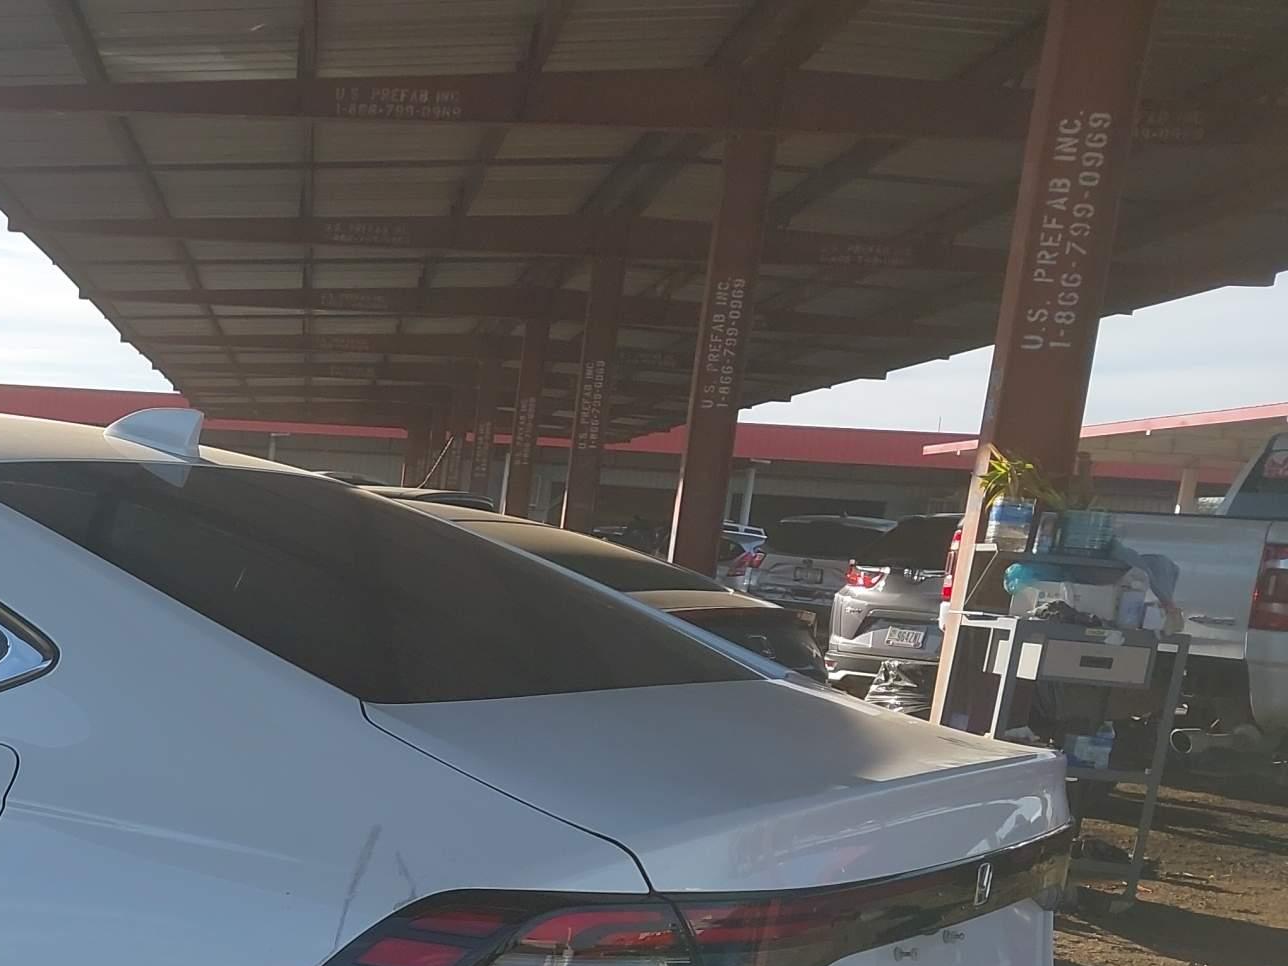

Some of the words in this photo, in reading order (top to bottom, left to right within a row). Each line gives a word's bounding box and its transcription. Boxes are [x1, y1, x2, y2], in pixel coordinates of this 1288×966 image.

[1054, 111, 1084, 161] INC.
[1033, 178, 1072, 282] PREFAB
[1049, 112, 1111, 348] 1-866-799-0969
[706, 313, 726, 372] PREFAB
[1021, 301, 1051, 349] U.S.
